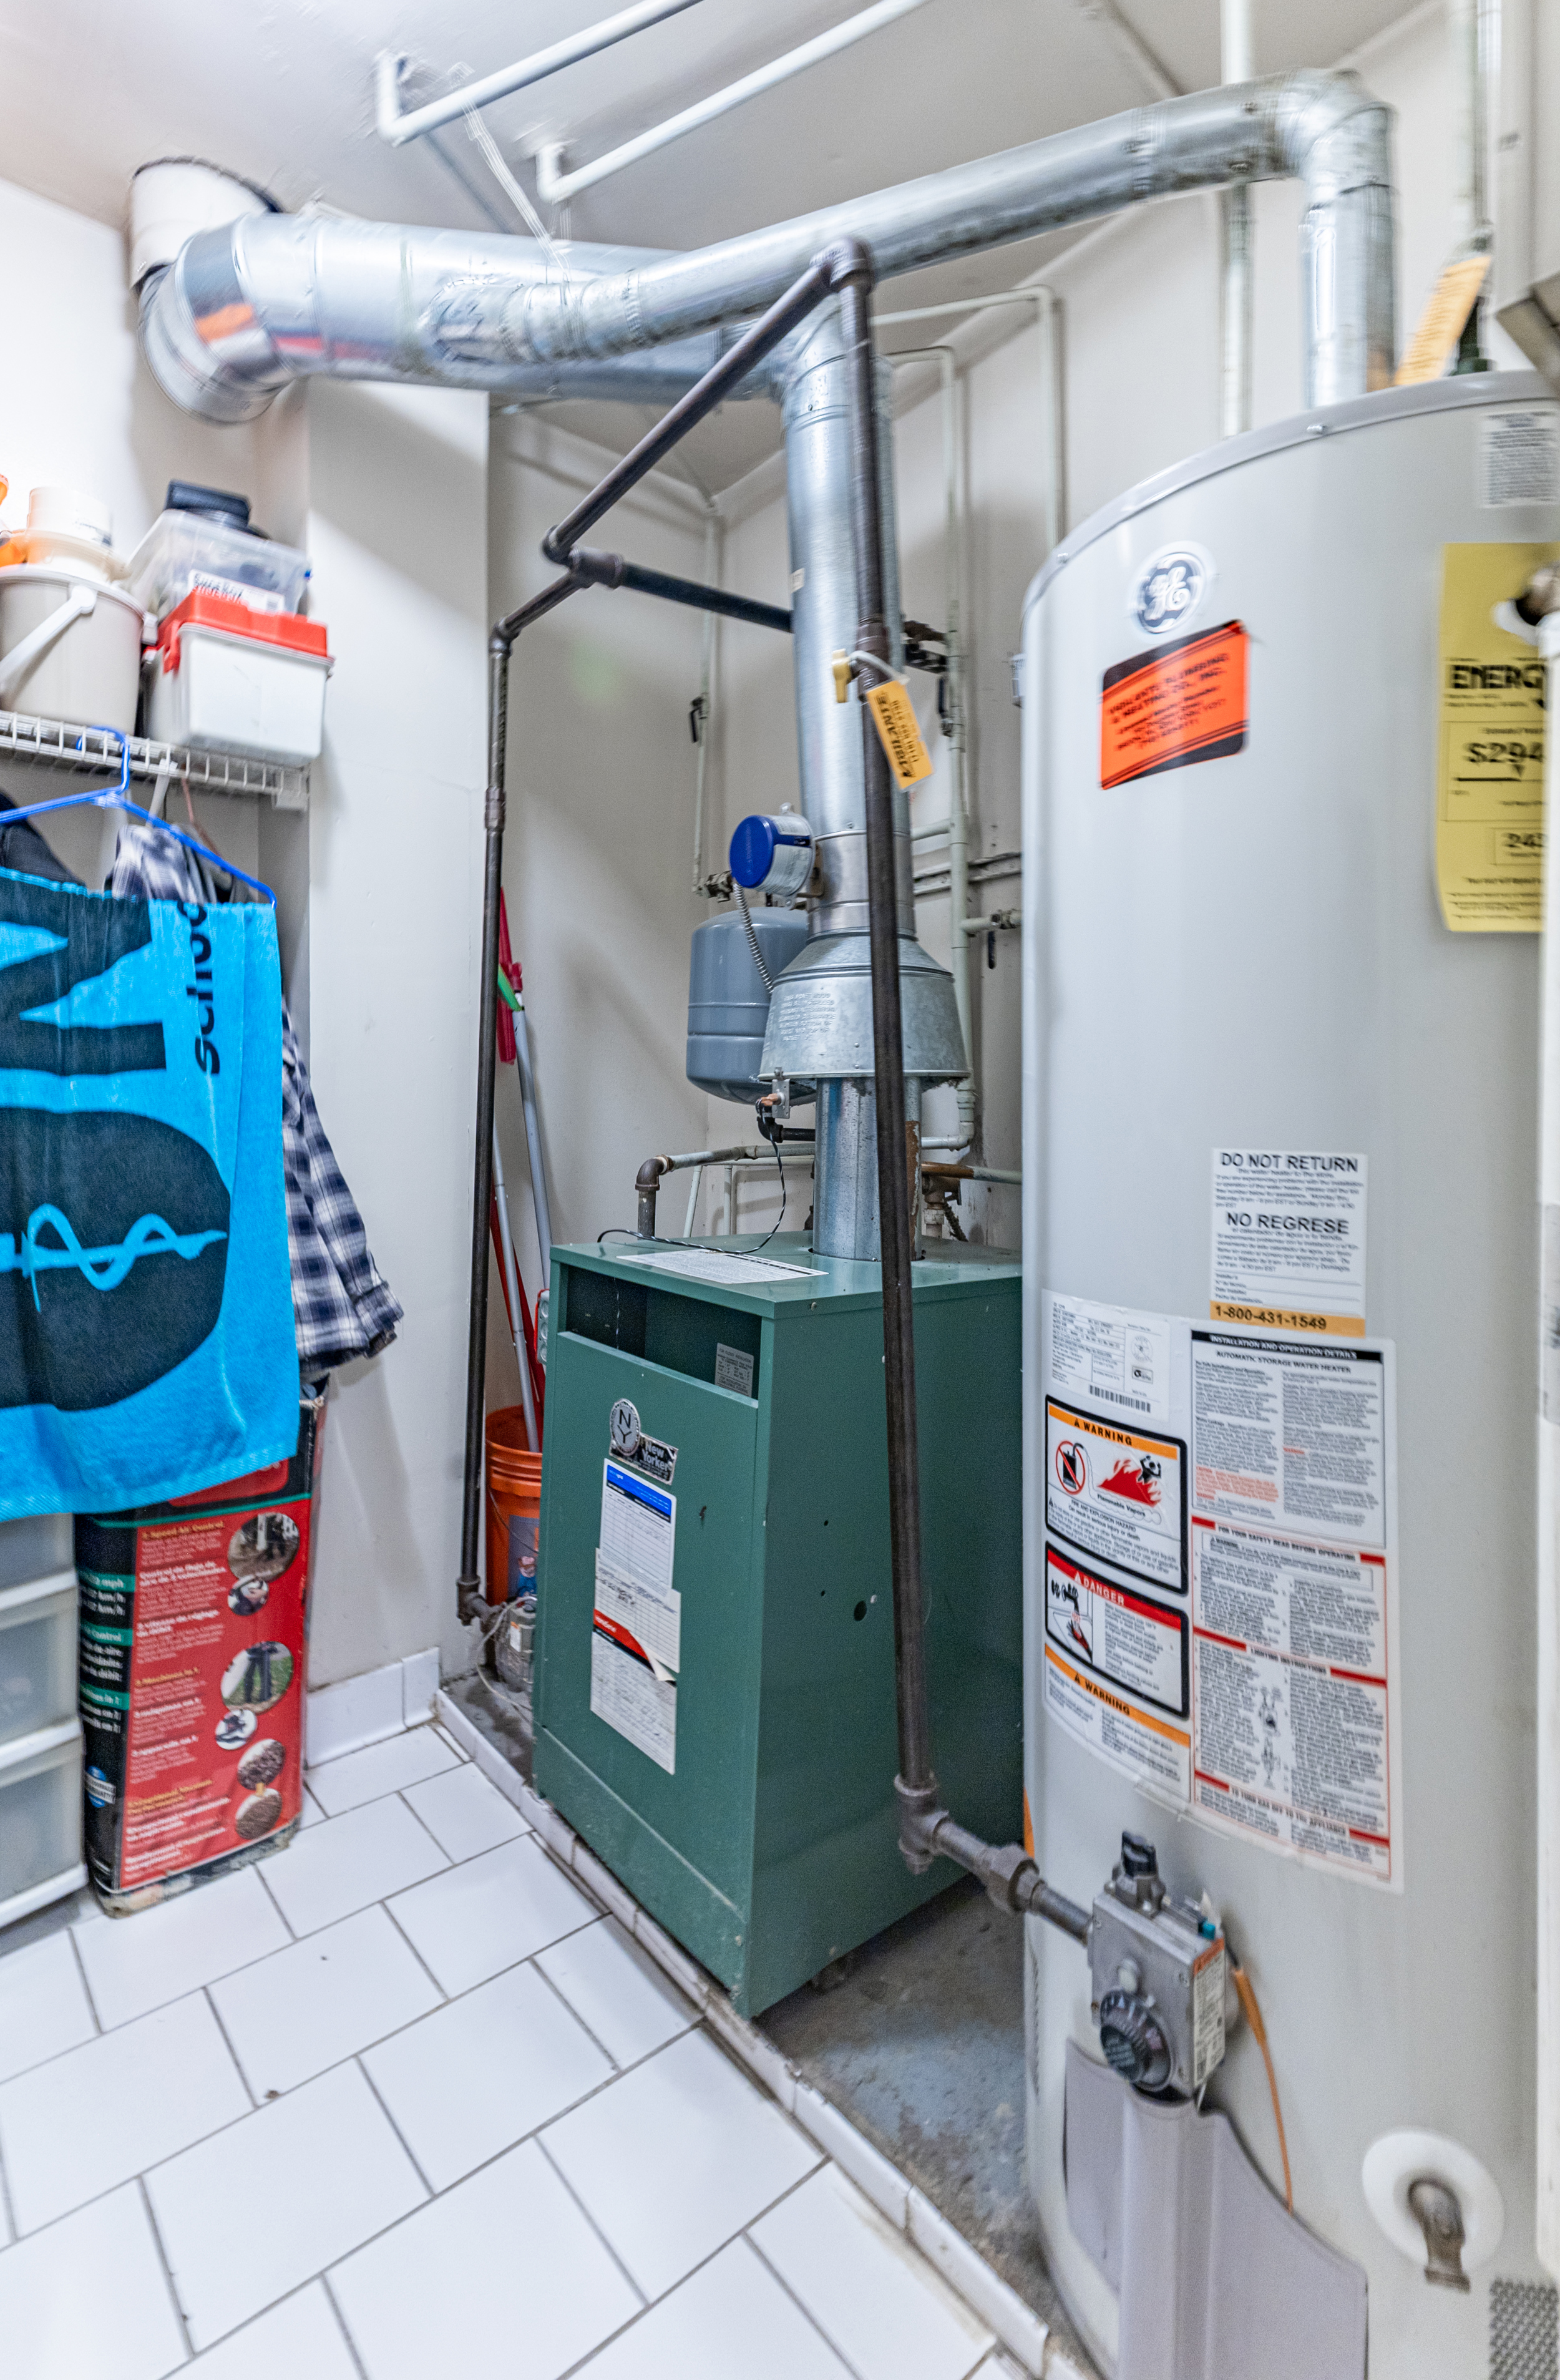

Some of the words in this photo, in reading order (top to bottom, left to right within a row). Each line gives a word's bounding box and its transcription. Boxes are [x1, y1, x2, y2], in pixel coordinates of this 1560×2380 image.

[1451, 664, 1545, 690] ENERG
[1221, 1153, 1244, 1167] DO
[1248, 1153, 1282, 1168] NOT
[1287, 1154, 1358, 1172] RETURN
[1227, 1212, 1252, 1227] NO
[1257, 1214, 1350, 1235] REGRESE
[1216, 1304, 1327, 1330] 1-800-431-1549
[1209, 1334, 1260, 1349] INSTALLATION
[1279, 1344, 1324, 1356] OPERATION
[1083, 1421, 1133, 1446] WARNING
[641, 1449, 670, 1471] Yorker
[645, 1441, 665, 1458] New
[1097, 1493, 1125, 1510] Flammable
[1126, 1505, 1146, 1518] Vapors
[1248, 1532, 1272, 1544] SAFETY
[1083, 1577, 1125, 1606] DANGER
[1085, 1679, 1130, 1716] WARNING
